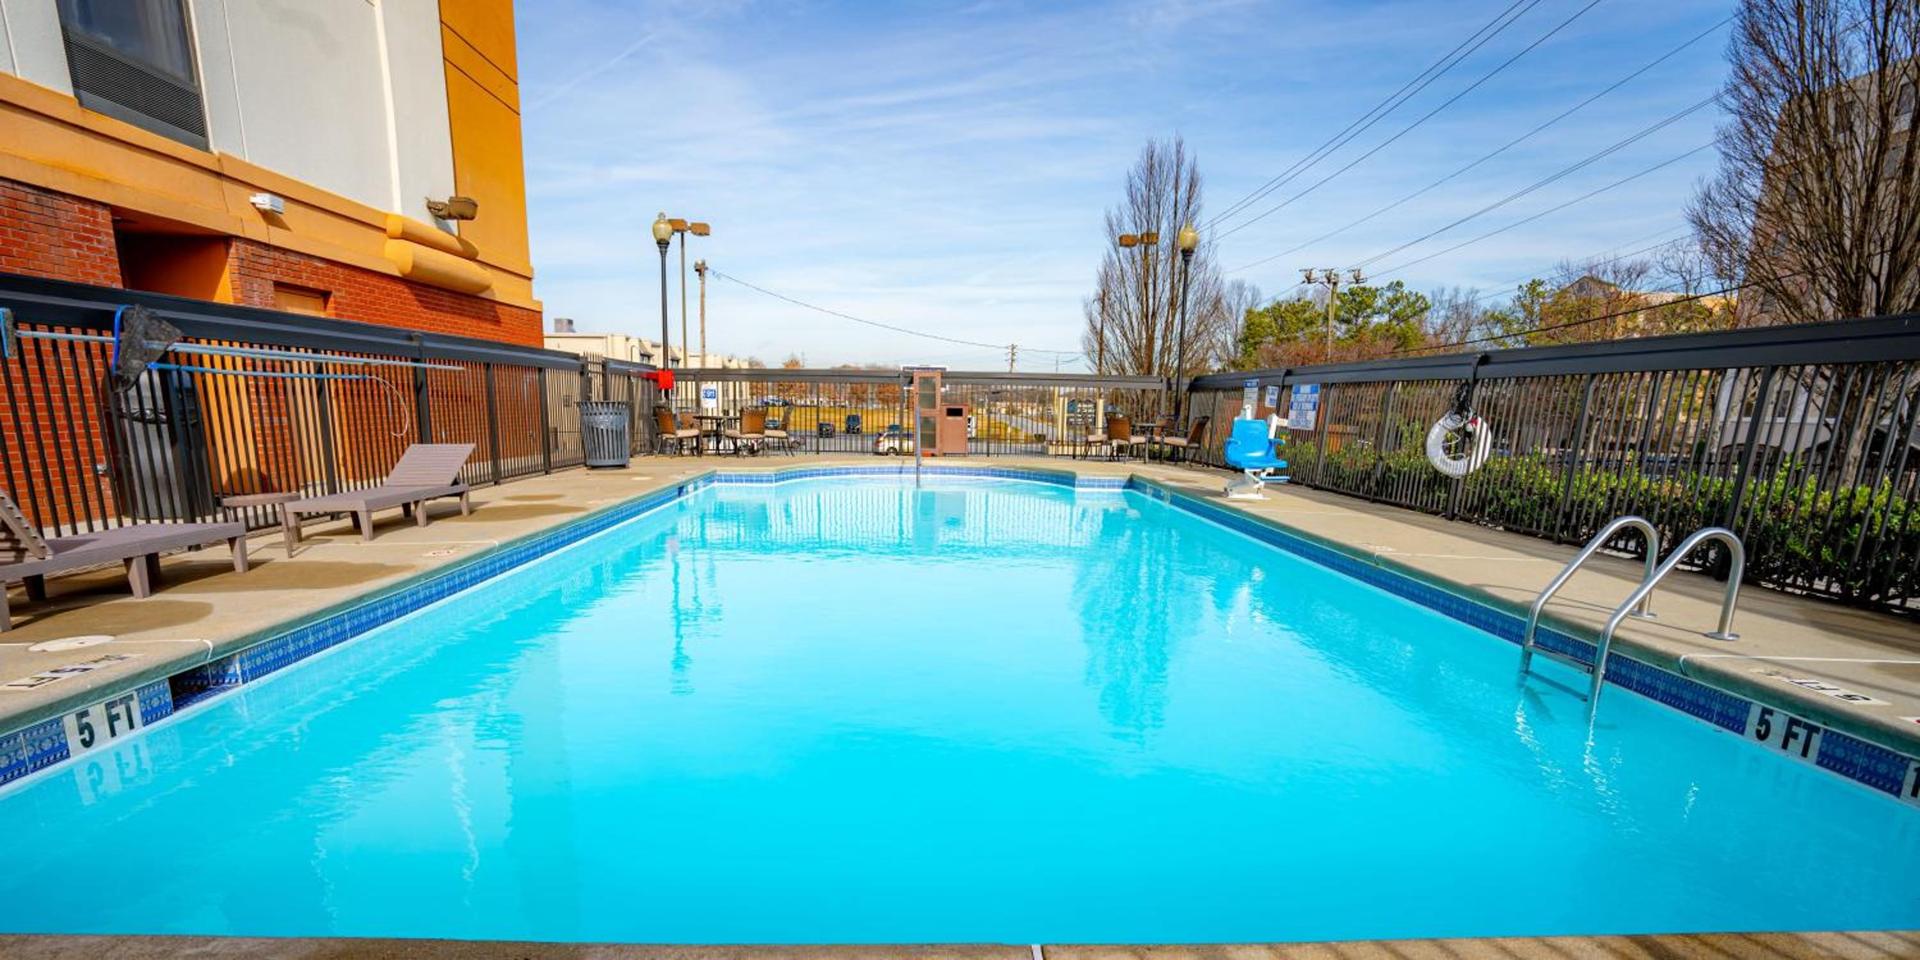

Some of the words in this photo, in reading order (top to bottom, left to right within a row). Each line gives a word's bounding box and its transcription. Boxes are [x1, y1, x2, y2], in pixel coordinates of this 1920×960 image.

[76, 710, 95, 749] 5
[104, 695, 137, 738] FT
[1755, 707, 1774, 741] 5
[1781, 717, 1821, 758] FT
